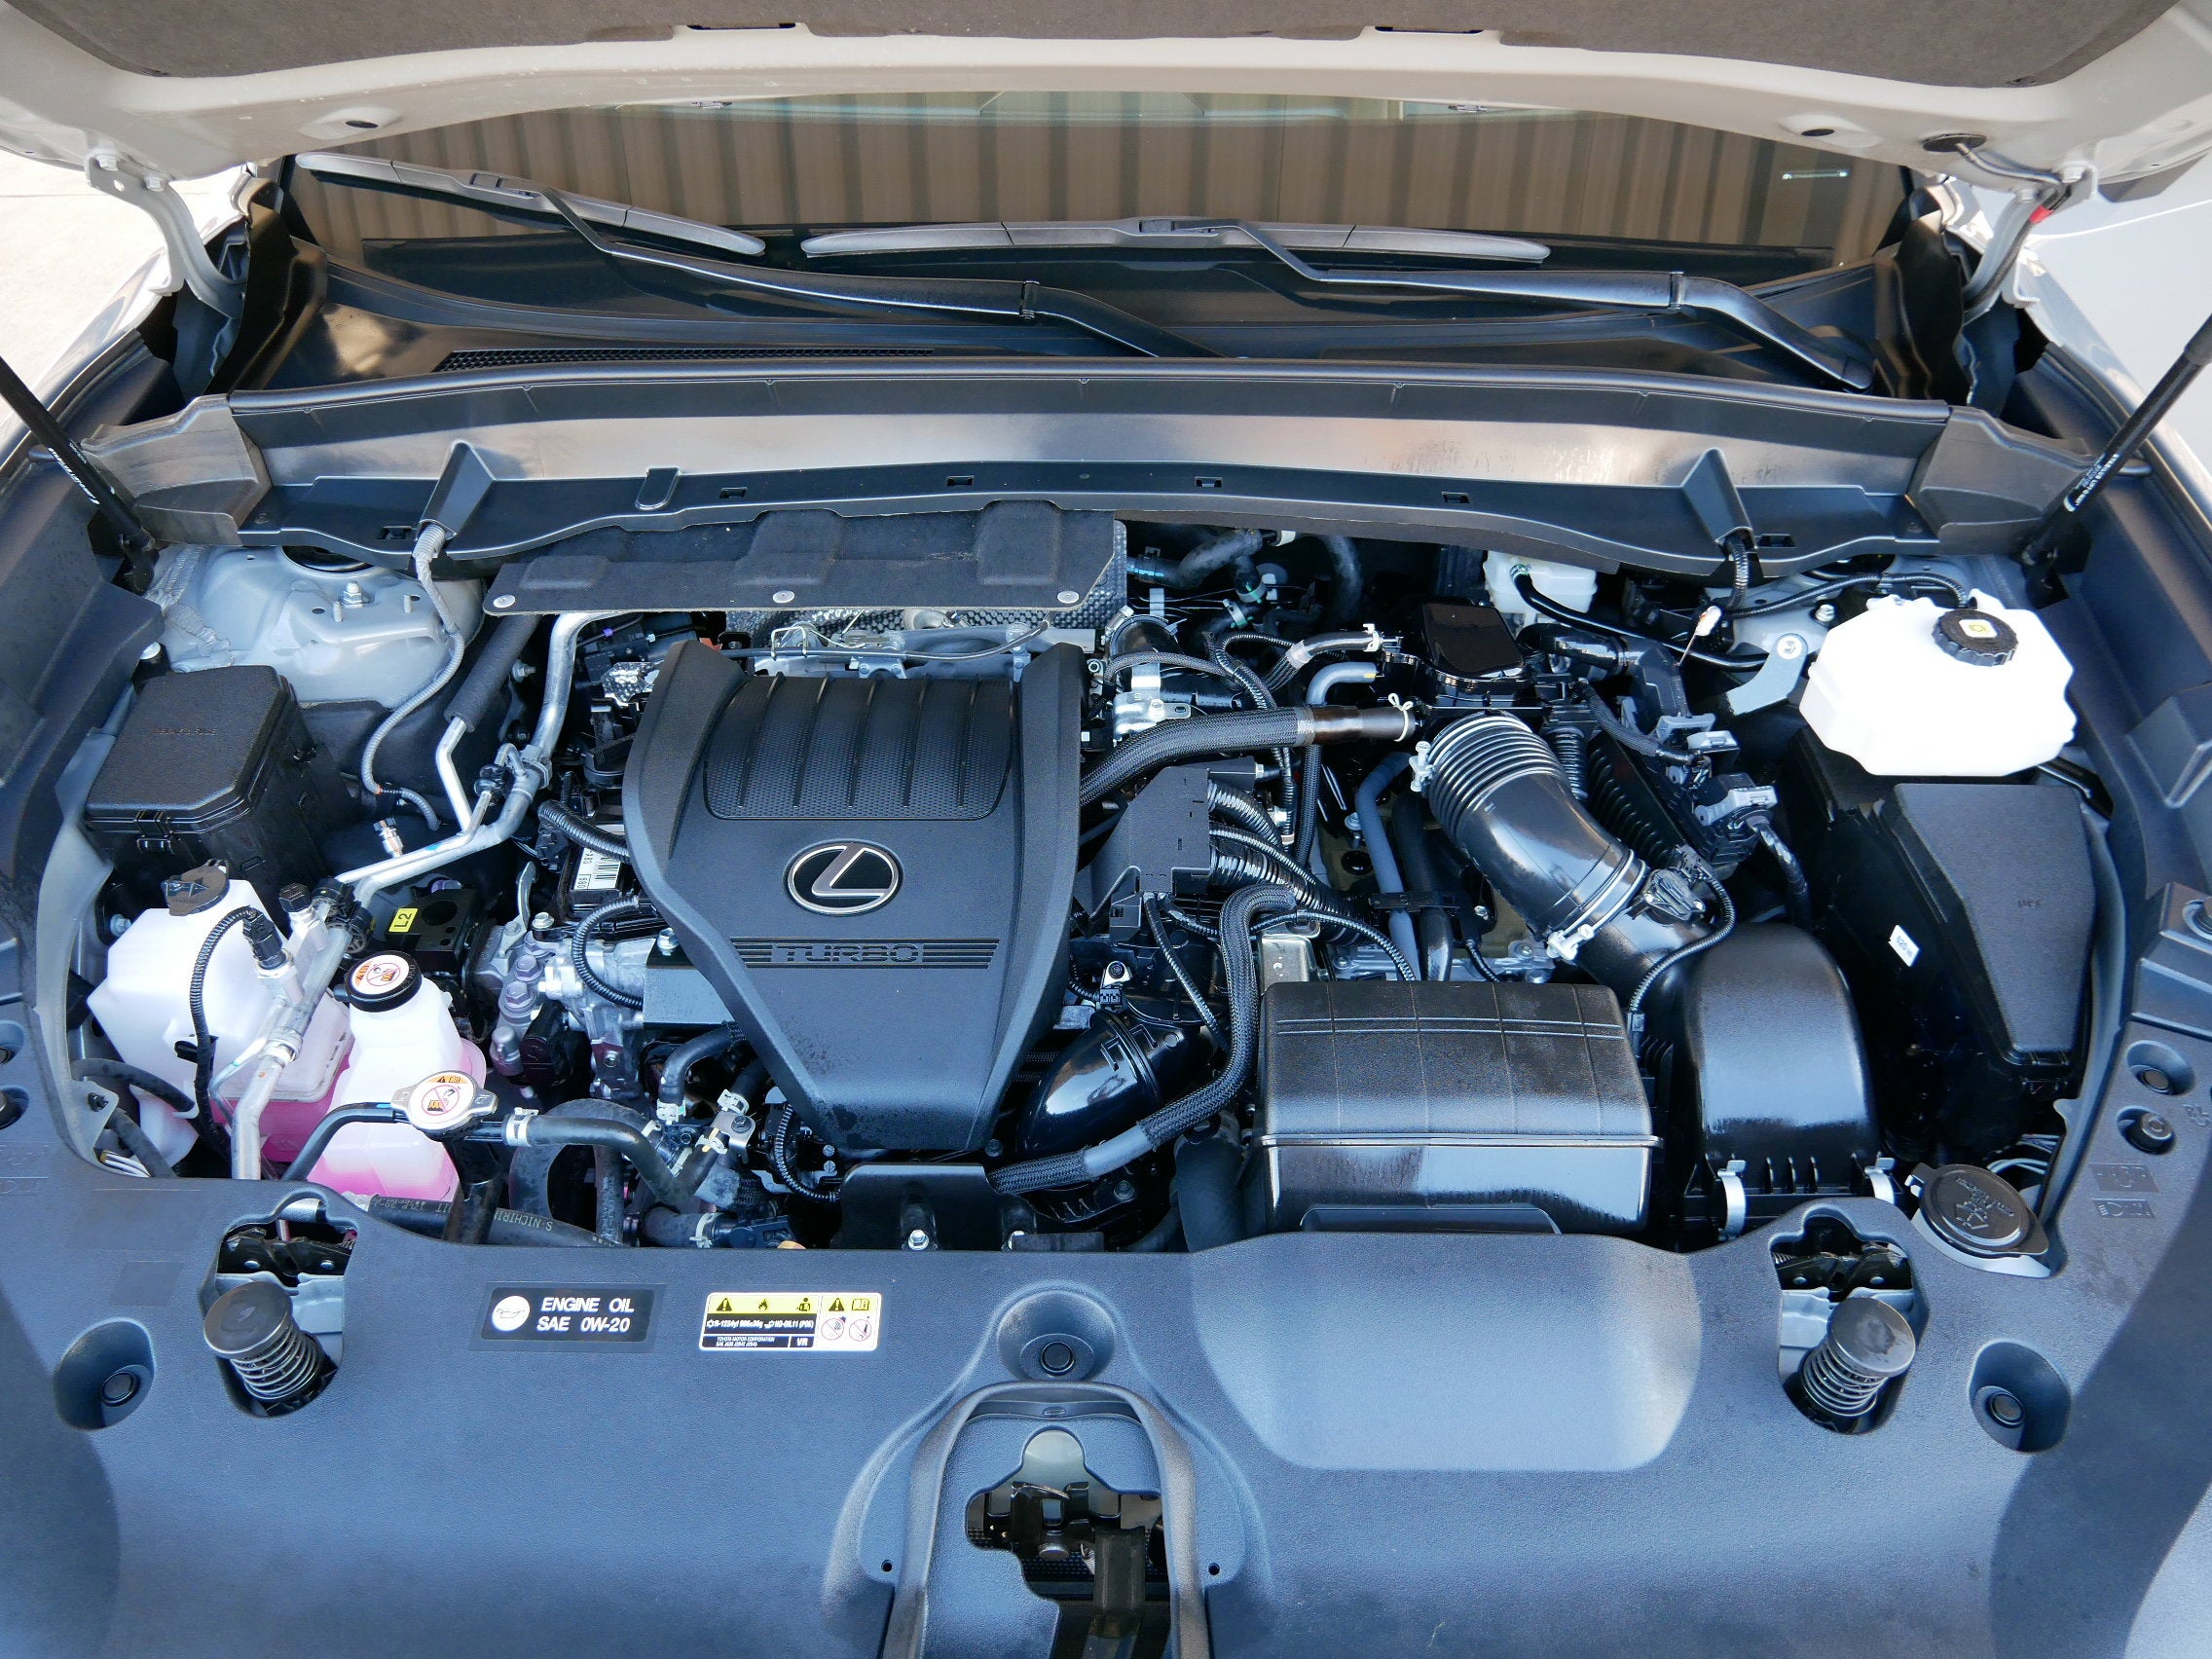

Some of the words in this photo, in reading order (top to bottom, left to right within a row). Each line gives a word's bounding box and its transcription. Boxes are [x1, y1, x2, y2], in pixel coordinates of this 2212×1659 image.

[393, 913, 413, 928] L2
[776, 943, 919, 962] TURBO
[541, 1297, 600, 1312] ENGINE
[608, 1298, 635, 1313] OIL
[536, 1316, 570, 1332] SAE
[580, 1317, 631, 1333] 0W-20
[796, 1337, 809, 1347] VR
